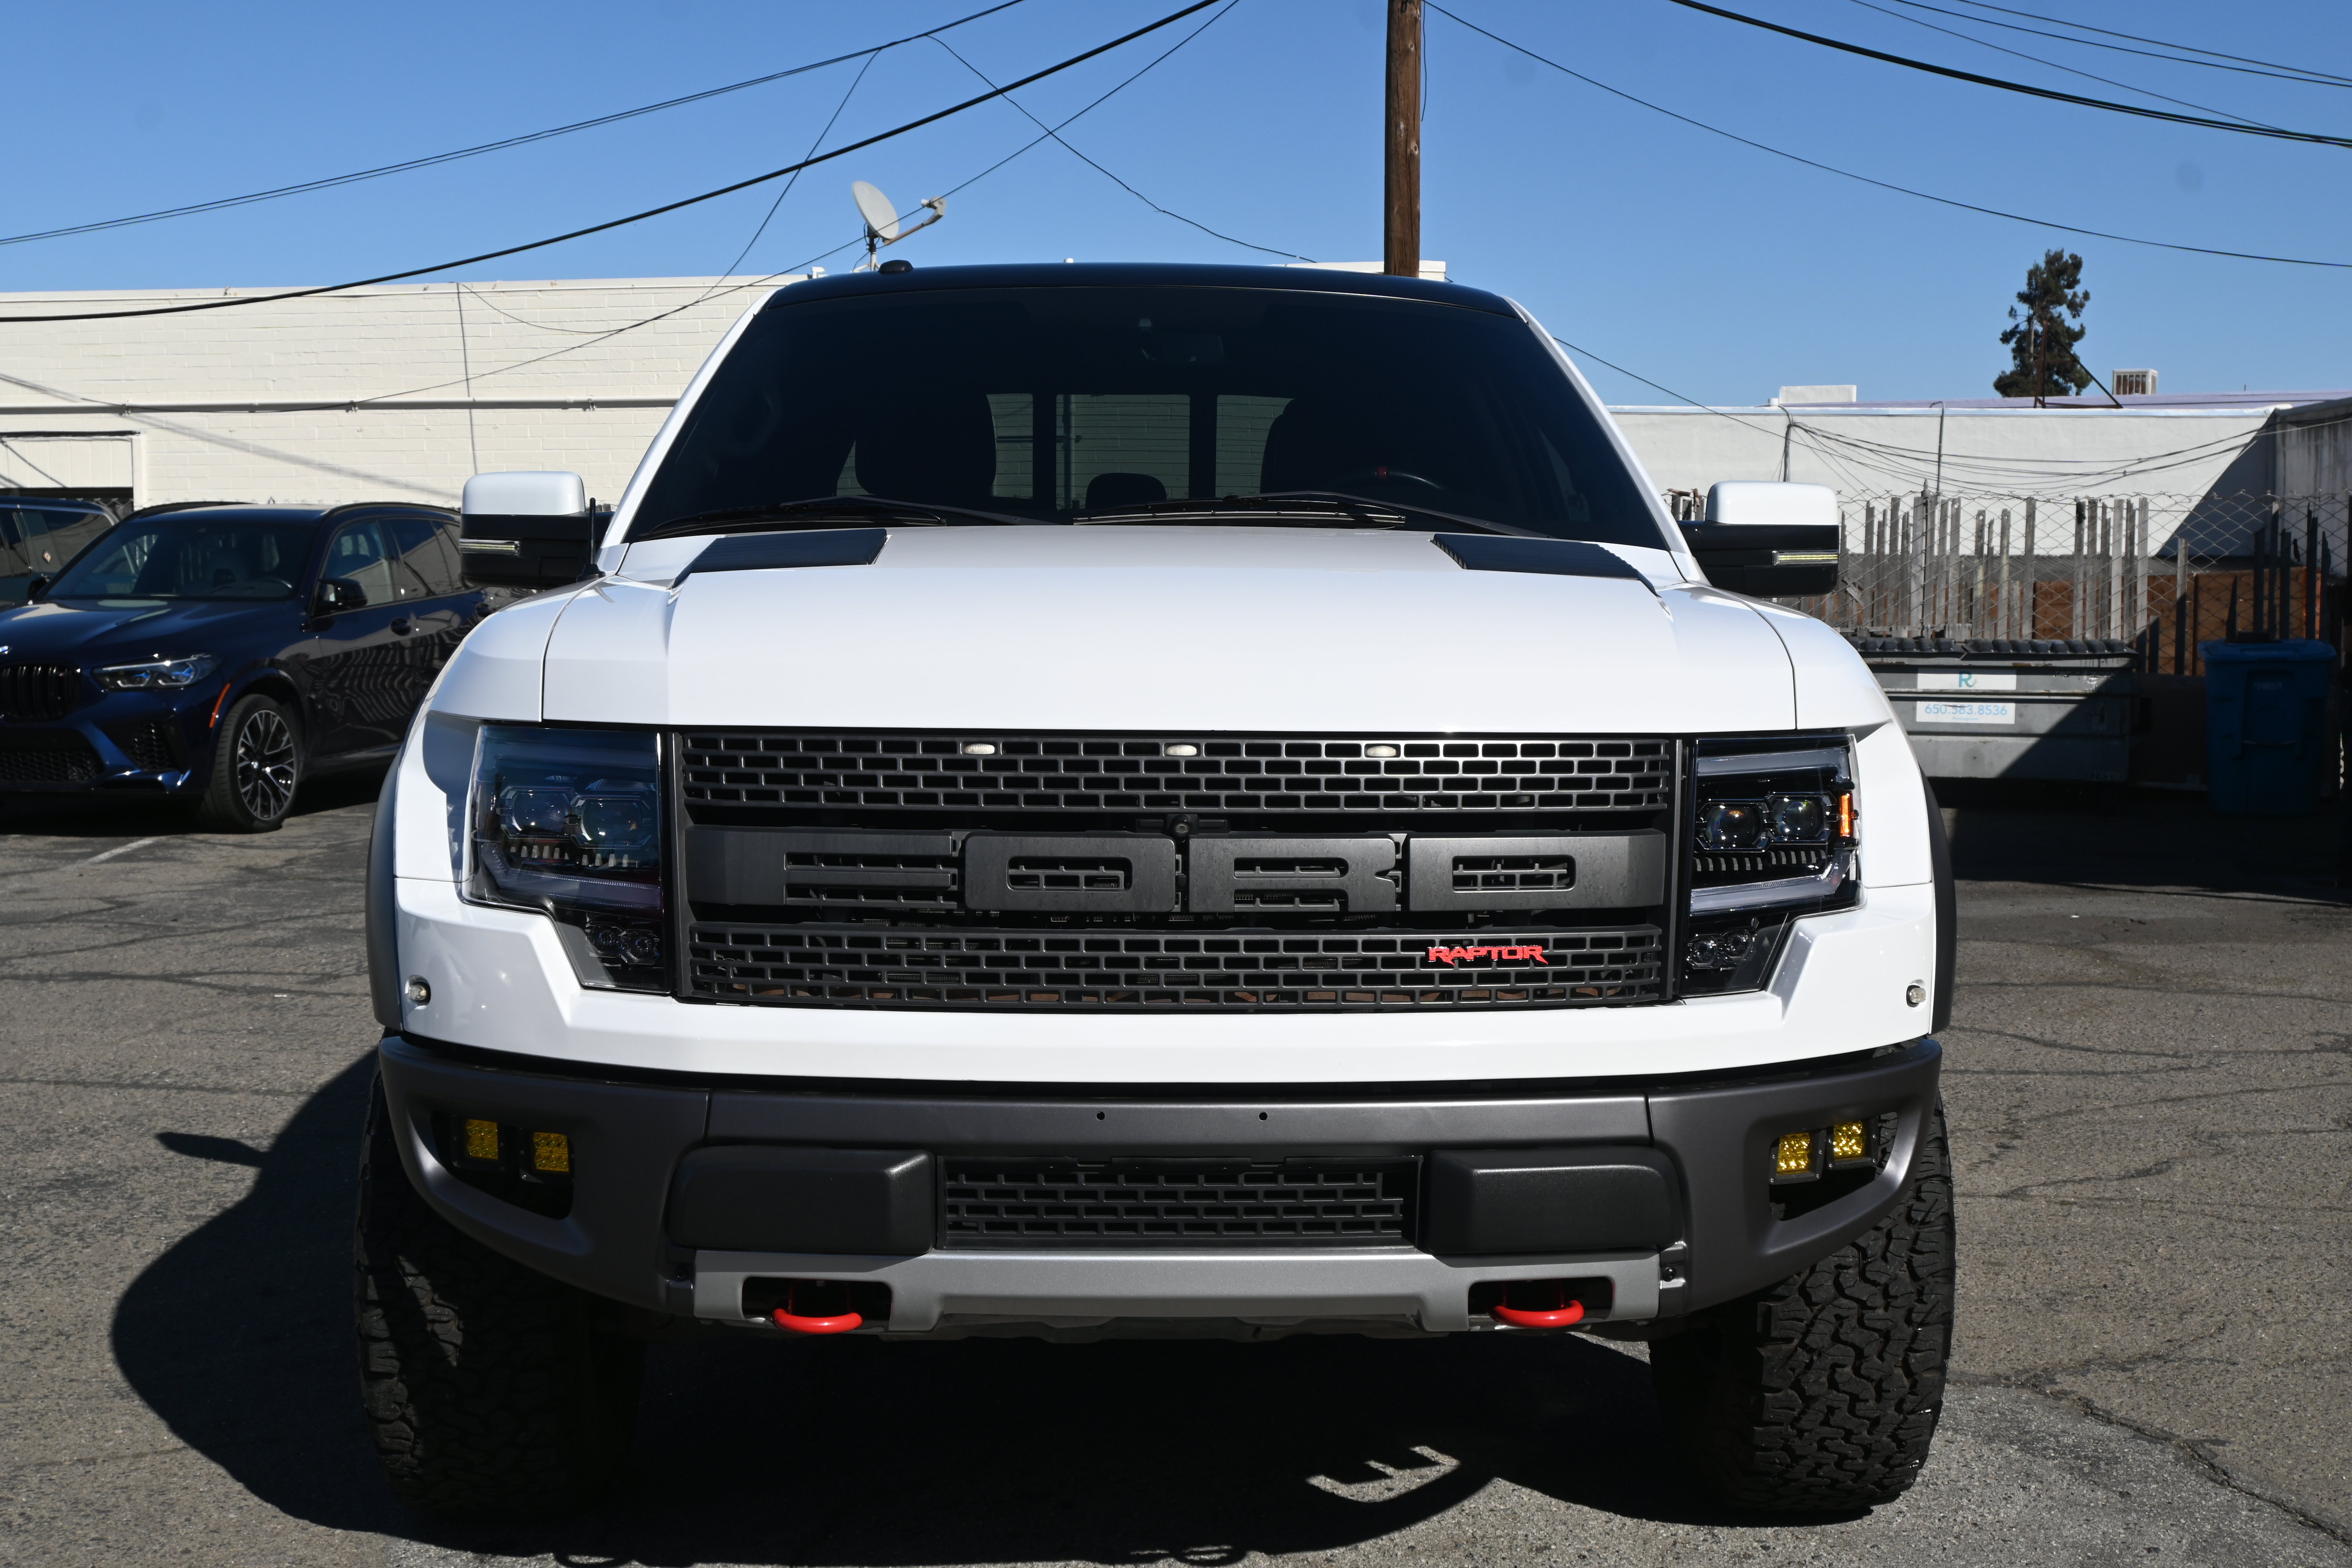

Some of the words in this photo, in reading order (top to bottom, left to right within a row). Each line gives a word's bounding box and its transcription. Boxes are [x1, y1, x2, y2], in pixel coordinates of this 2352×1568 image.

[1959, 671, 1975, 688] R
[1925, 704, 2008, 716] 650.583.8536
[686, 830, 1665, 912] FORD
[1428, 945, 1548, 966] RAPTOR
